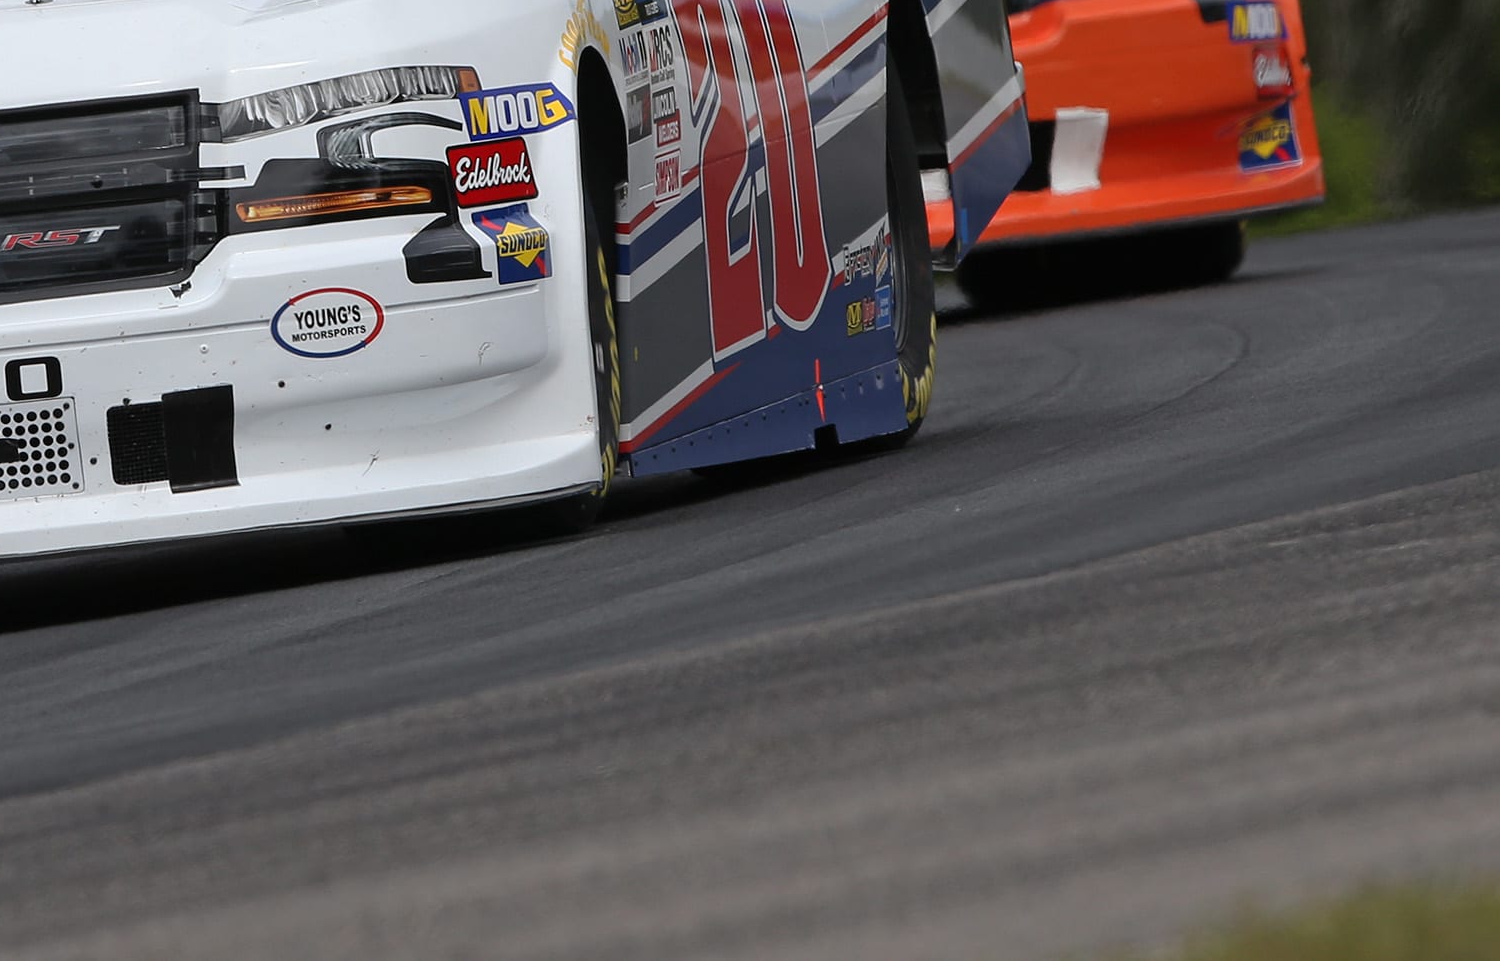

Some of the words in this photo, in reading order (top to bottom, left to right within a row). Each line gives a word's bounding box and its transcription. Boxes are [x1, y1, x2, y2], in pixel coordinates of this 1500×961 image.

[468, 89, 567, 136] MOOG
[455, 152, 531, 193] Edelbrock
[0, 225, 121, 251] RST
[500, 229, 546, 255] SUNOCO
[294, 304, 361, 330] YOUNG'S
[292, 325, 366, 342] MOTORSPORTS
